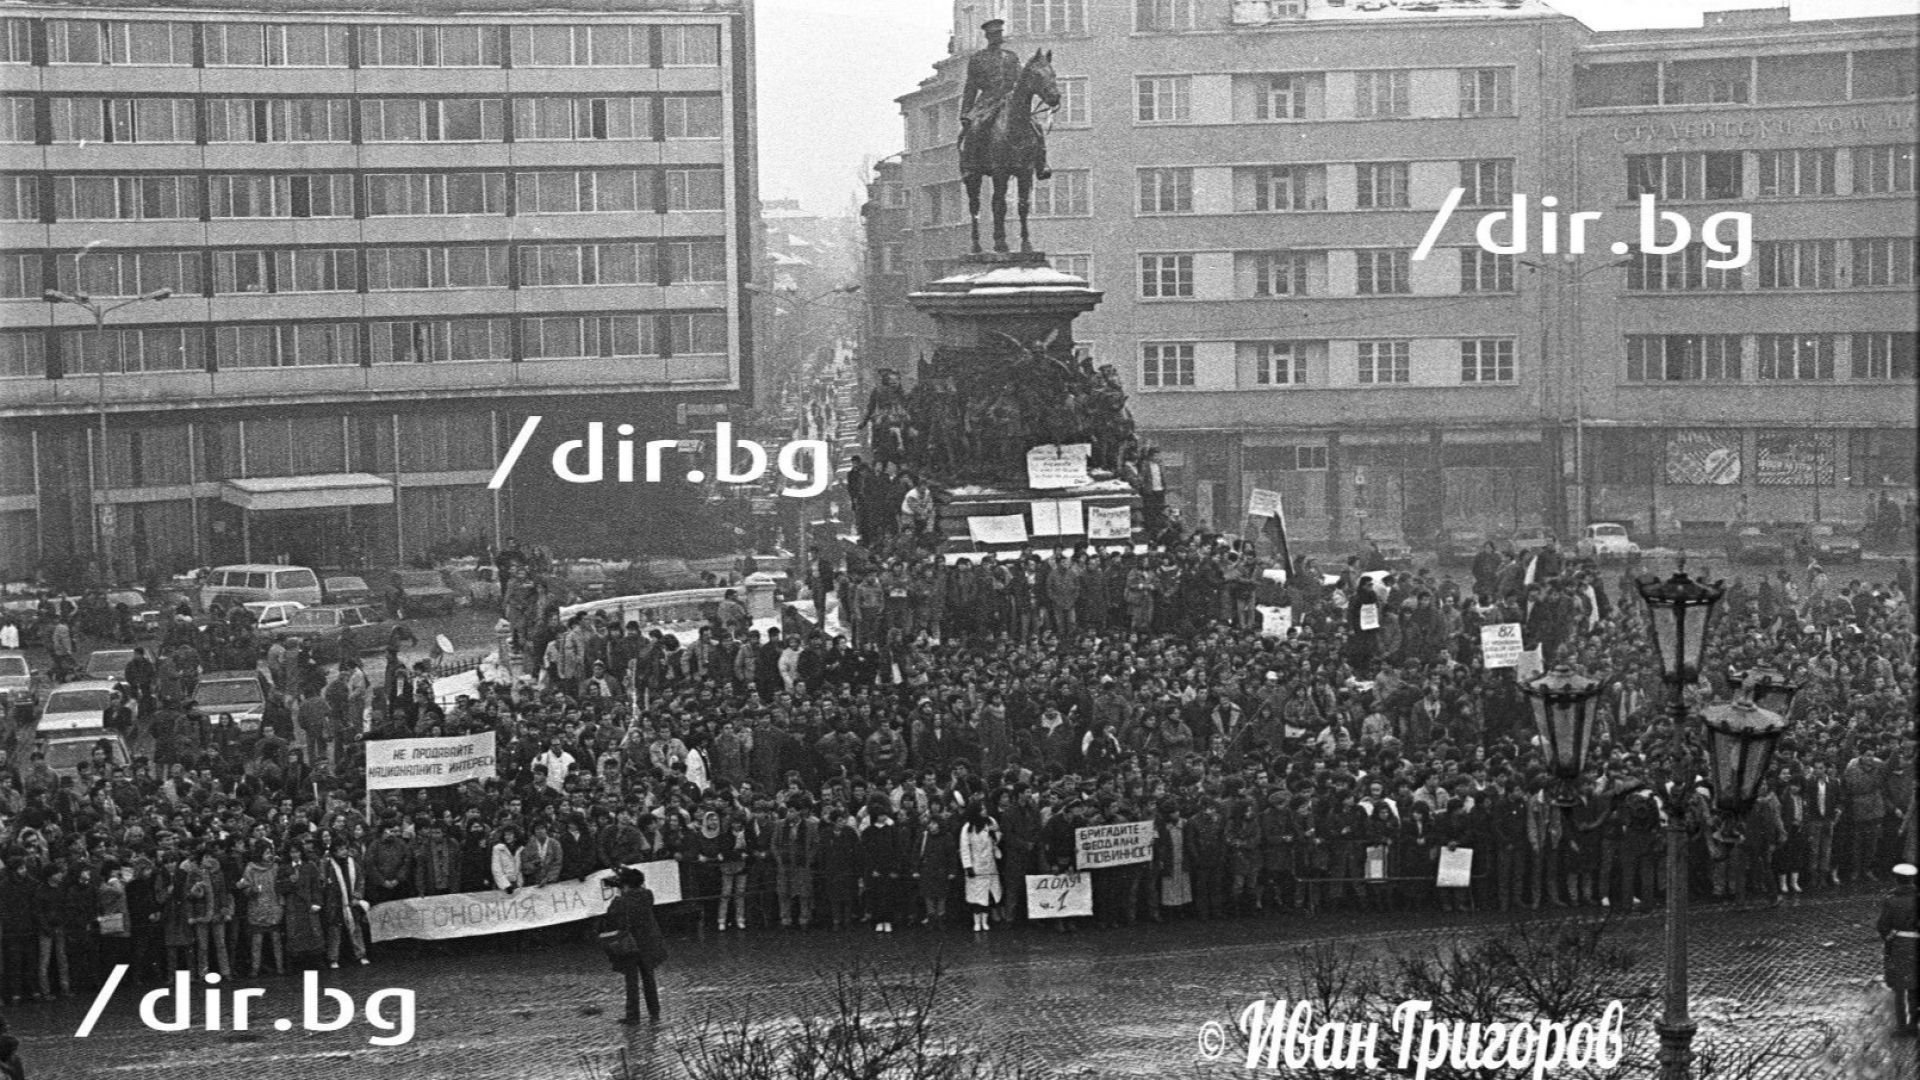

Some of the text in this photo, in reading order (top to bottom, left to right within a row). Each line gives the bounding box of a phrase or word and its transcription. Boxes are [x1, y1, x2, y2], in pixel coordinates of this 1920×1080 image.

[393, 744, 474, 760] НЕ ПРОДАВАЙТЕ
[368, 763, 442, 778] НАЦИОНАЛНИТЕ
[1080, 825, 1139, 840] БРИГАДИТЕ
[1081, 837, 1140, 851] ФЕОДАЛНА
[379, 899, 537, 931] АВТОНОМИЯ
[551, 890, 586, 914] НА
